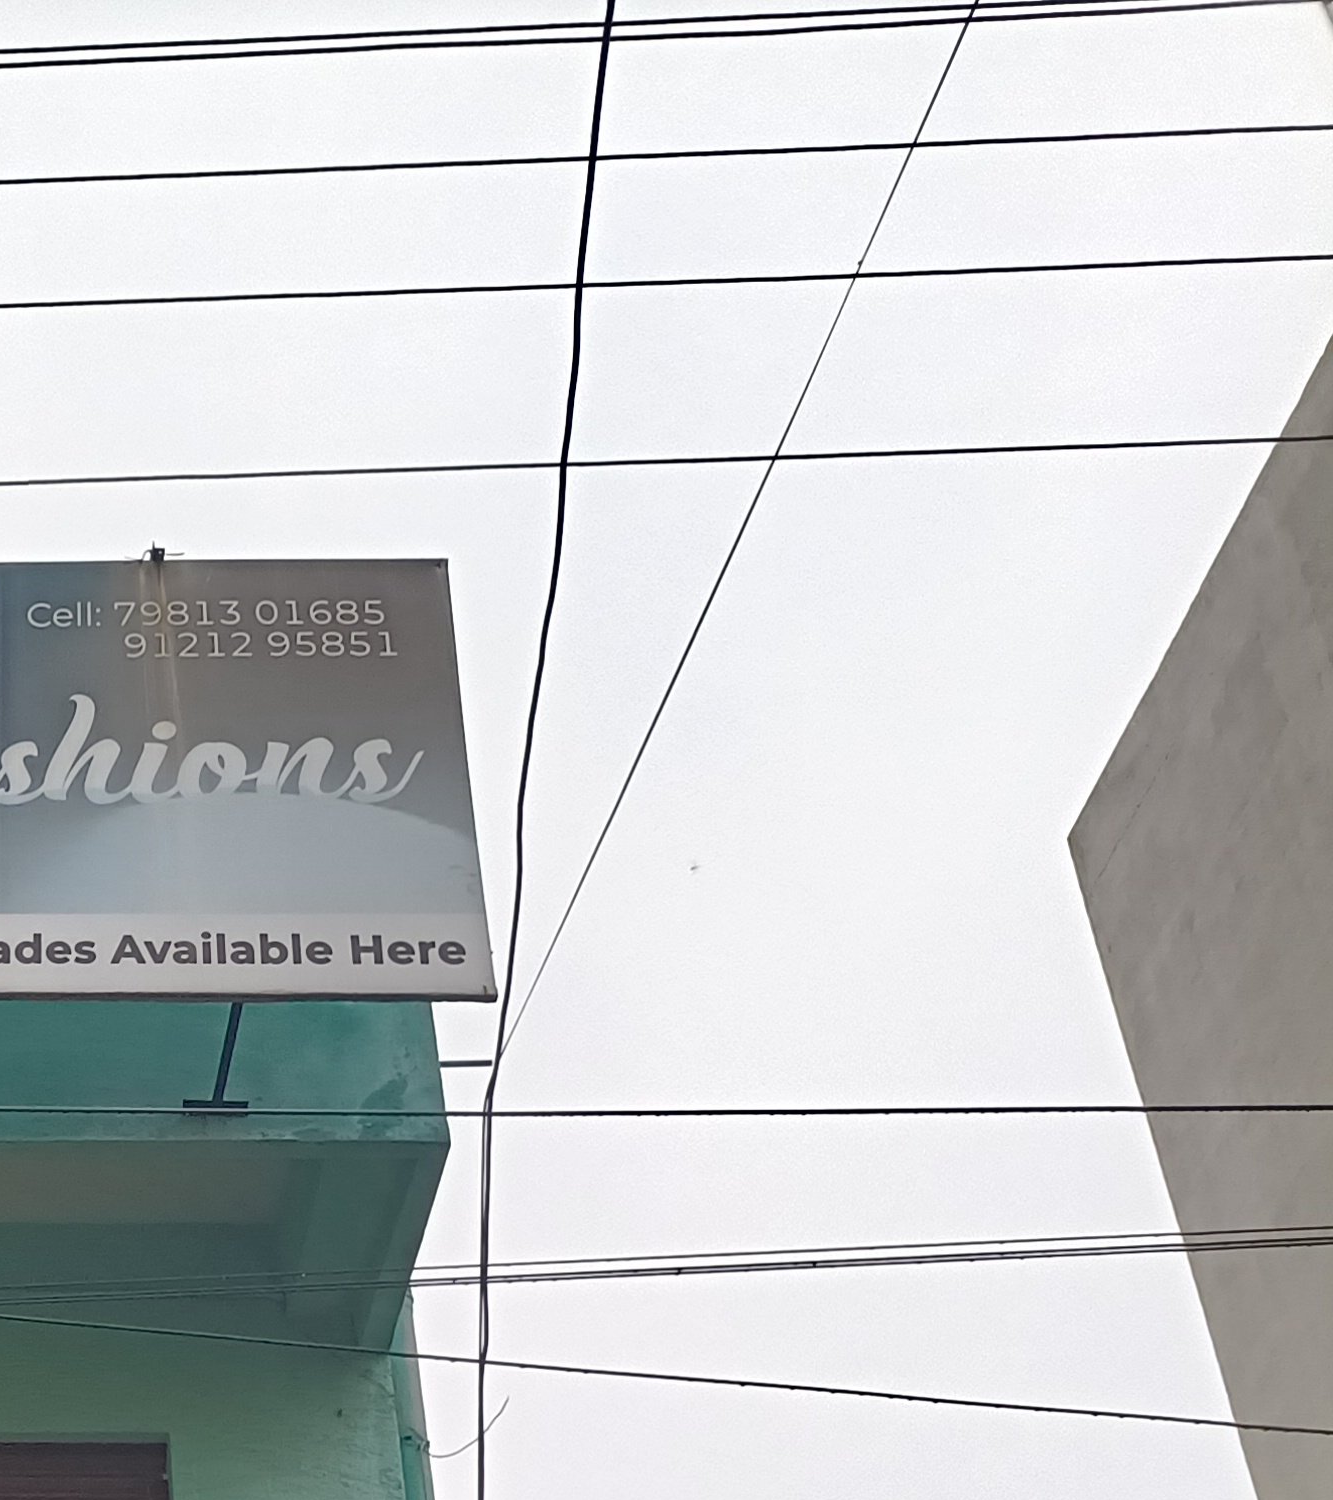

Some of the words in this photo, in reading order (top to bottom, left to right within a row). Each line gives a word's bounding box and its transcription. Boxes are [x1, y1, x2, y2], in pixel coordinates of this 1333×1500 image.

[25, 599, 103, 631] Cell:
[113, 599, 244, 629] 79813
[254, 599, 386, 628] 01685
[124, 630, 253, 660] 91212
[267, 630, 400, 659] 95851
[111, 932, 335, 967] Available
[350, 934, 467, 967] Here
